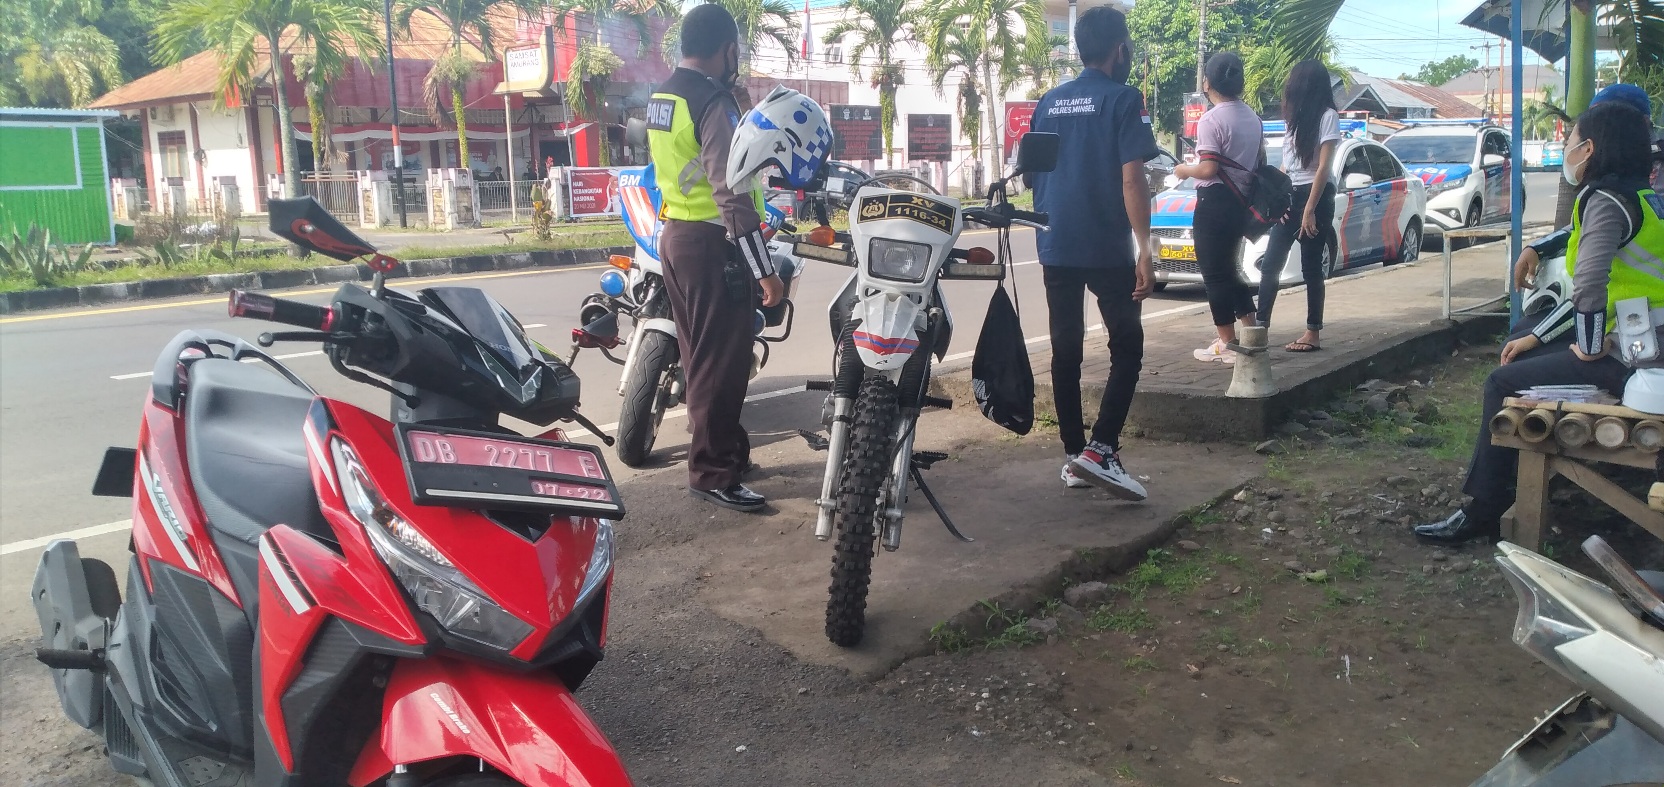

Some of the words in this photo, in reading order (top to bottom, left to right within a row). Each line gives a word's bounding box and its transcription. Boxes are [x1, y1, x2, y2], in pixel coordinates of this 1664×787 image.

[510, 50, 538, 60] SAMSAT
[1054, 97, 1092, 107] SATLANTAS
[646, 102, 673, 127] POLISI
[1048, 106, 1072, 116] POLRES
[1072, 104, 1096, 114] MINSEL
[620, 174, 641, 187] BM
[911, 196, 935, 208] XV
[895, 207, 947, 227] 1116-34
[417, 437, 458, 464] DB
[484, 444, 554, 473] 2277
[578, 455, 598, 478] E
[430, 692, 455, 714] Combi
[448, 713, 471, 734] Brake
